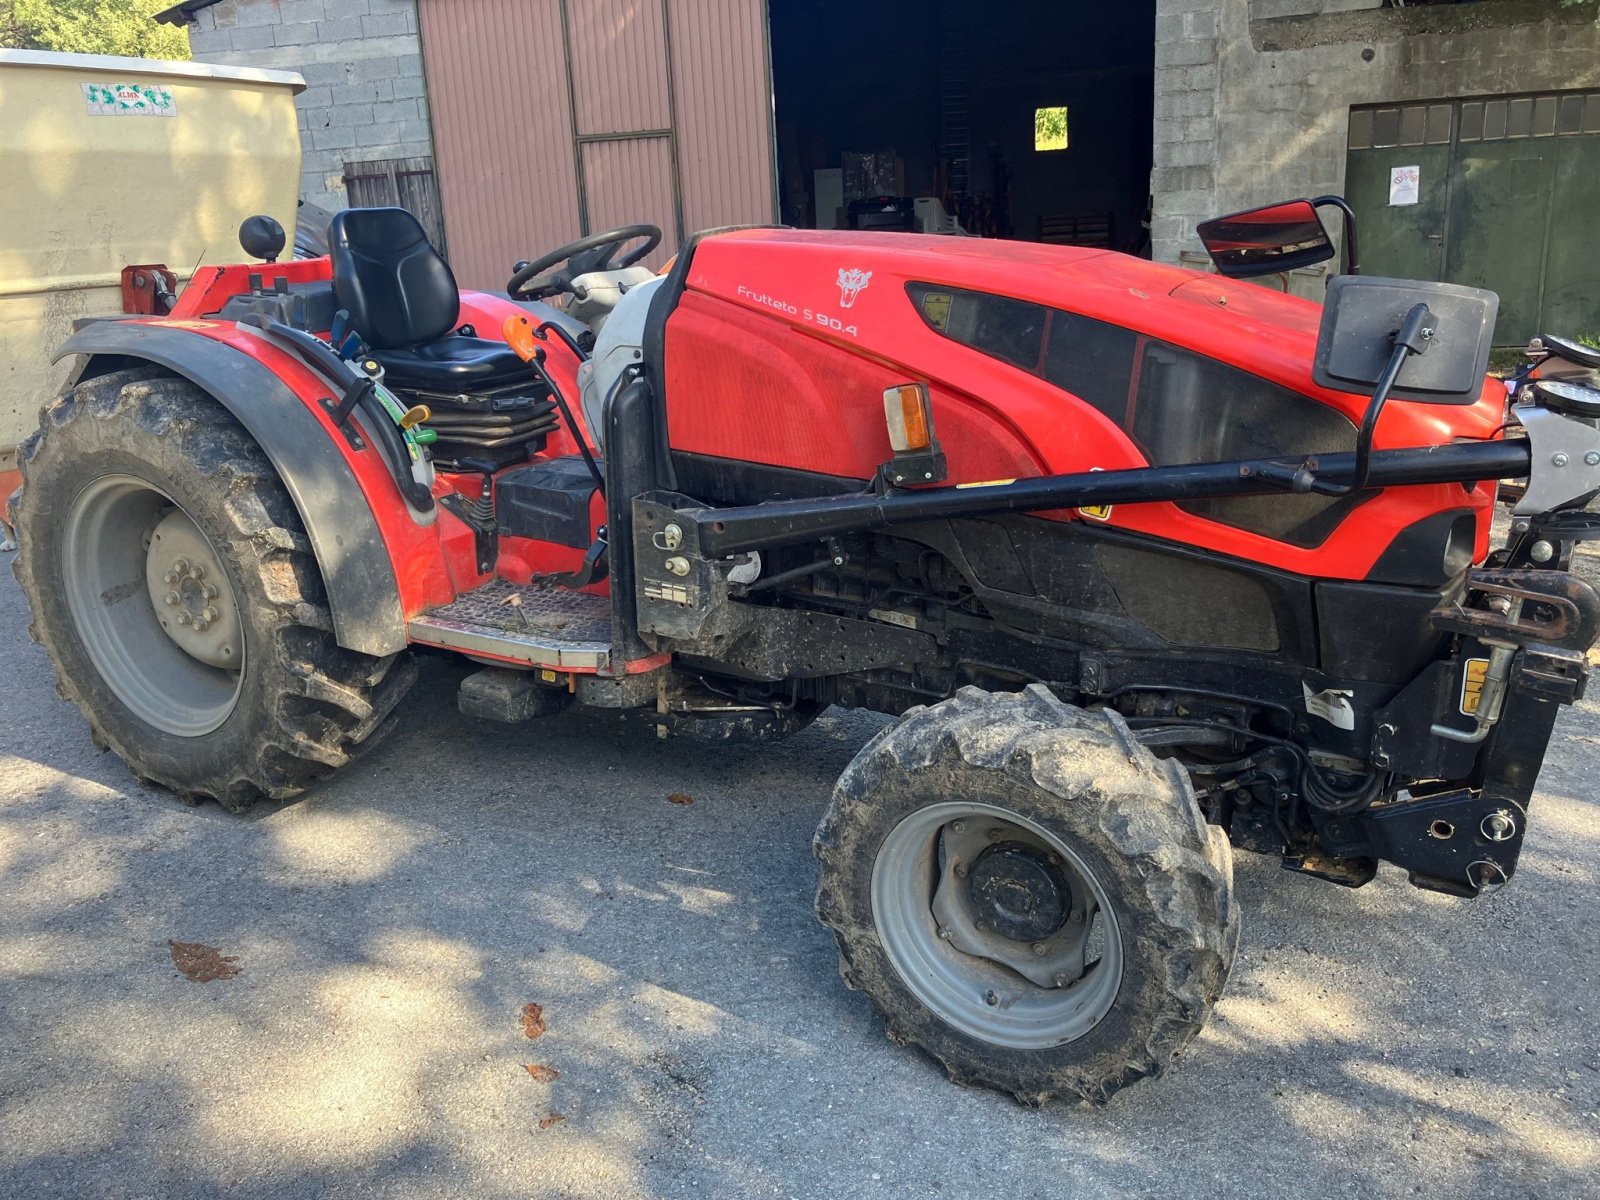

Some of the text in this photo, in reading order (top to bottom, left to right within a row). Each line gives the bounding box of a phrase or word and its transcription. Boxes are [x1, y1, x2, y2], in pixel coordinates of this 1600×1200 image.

[118, 91, 140, 99] ALMA
[737, 285, 858, 337] Frutteto S 90.4
